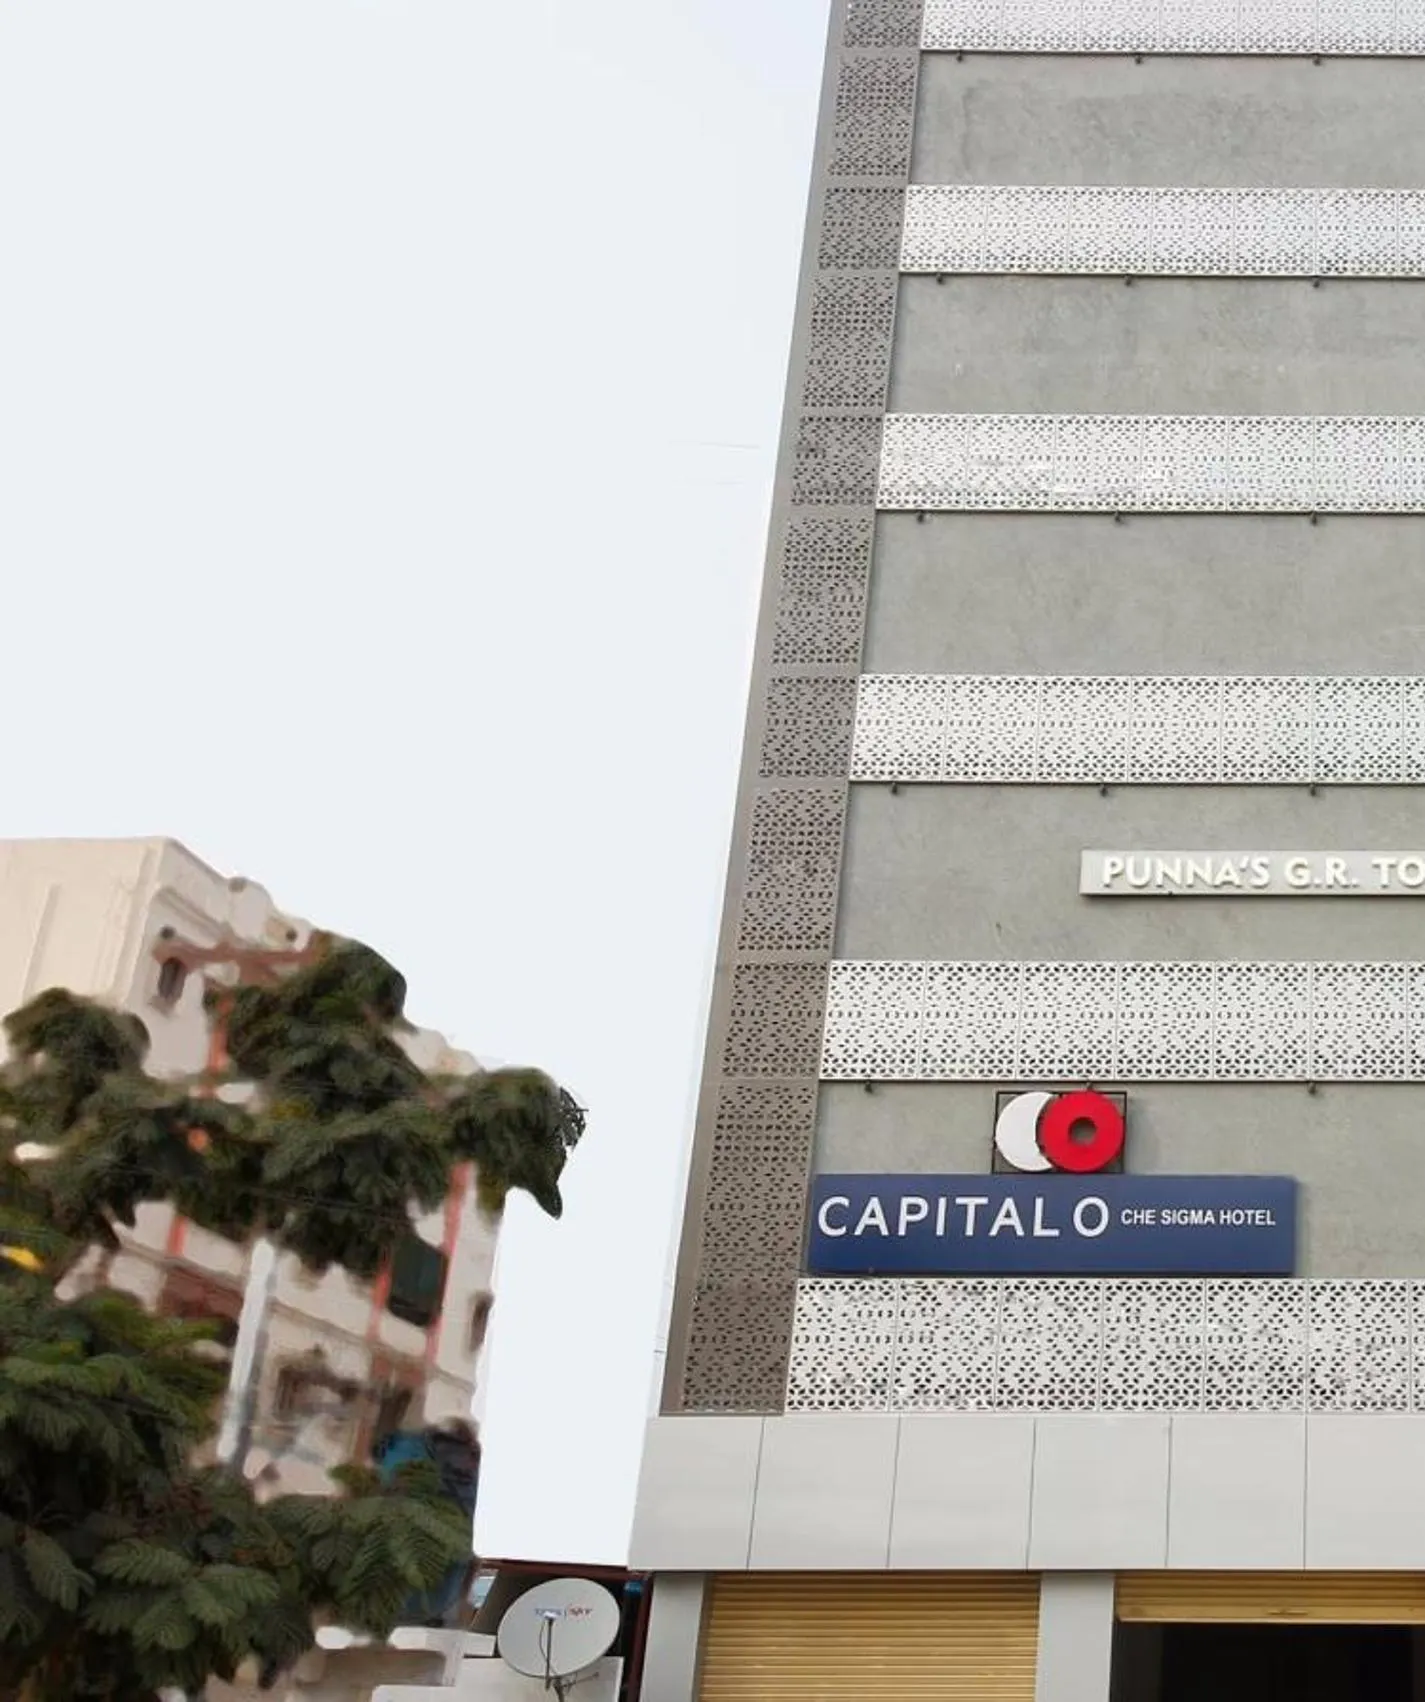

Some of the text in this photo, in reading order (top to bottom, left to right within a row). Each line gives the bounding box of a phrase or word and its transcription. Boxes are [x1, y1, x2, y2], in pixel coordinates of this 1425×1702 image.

[1103, 855, 1271, 888] PUNNA'S
[1284, 855, 1359, 888] G.R.
[817, 1196, 1061, 1238] CAPITAL
[1120, 1208, 1157, 1226] CHE
[1160, 1208, 1216, 1226] SIGMA
[1219, 1208, 1277, 1226] HOTEL
